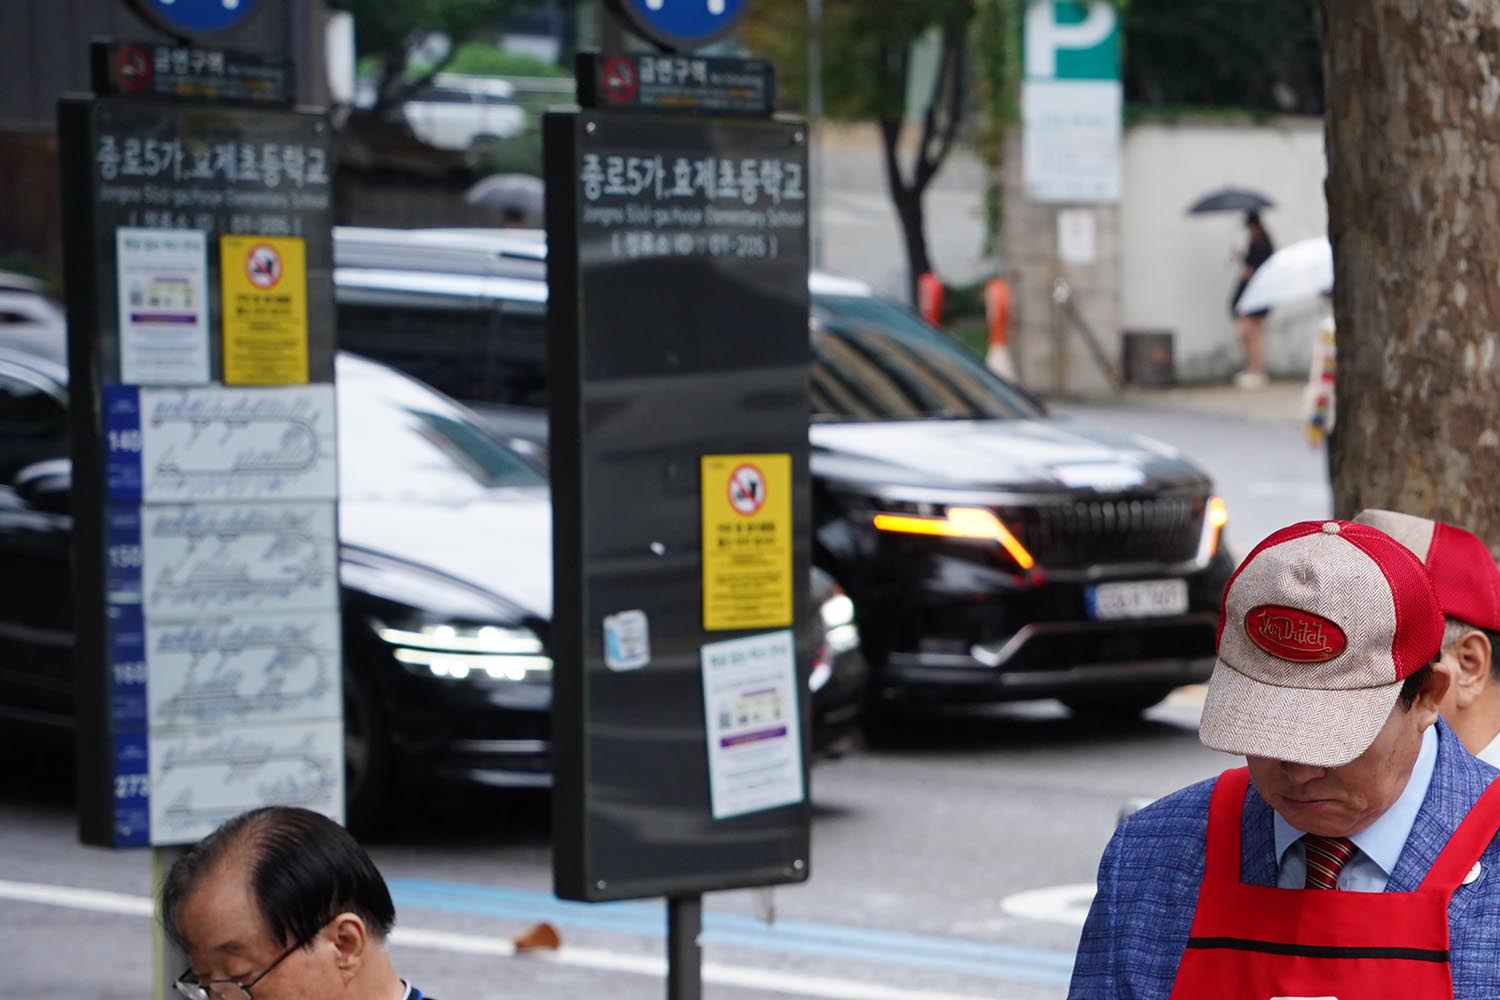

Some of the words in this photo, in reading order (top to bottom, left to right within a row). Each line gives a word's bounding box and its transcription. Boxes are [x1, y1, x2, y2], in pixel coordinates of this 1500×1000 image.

[639, 56, 708, 84] 금연구역
[1258, 610, 1282, 641] Von
[1275, 616, 1327, 649] Dutch
